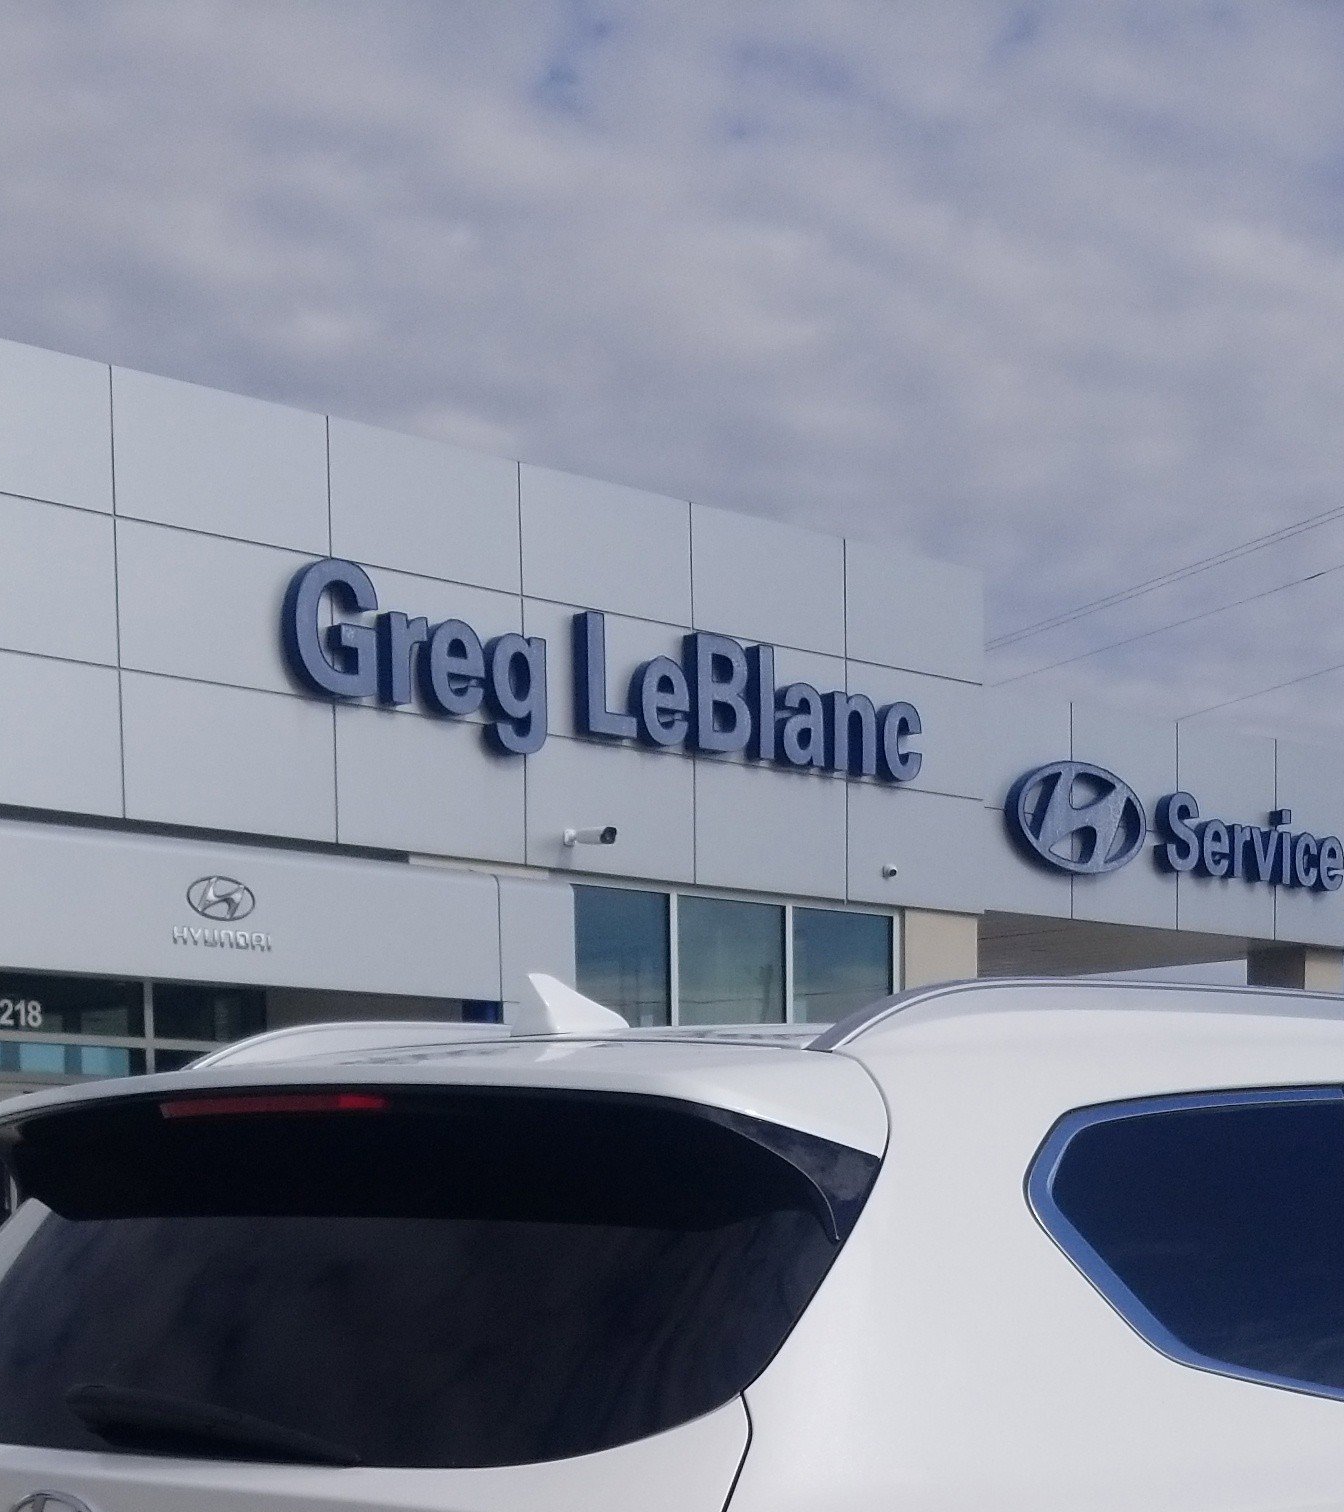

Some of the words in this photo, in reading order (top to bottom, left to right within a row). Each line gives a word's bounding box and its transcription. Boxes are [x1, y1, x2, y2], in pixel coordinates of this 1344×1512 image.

[282, 557, 547, 754] Greg
[572, 611, 923, 783] LeBlanc
[1154, 791, 1344, 892] Service
[172, 926, 272, 952] HYUNDAI
